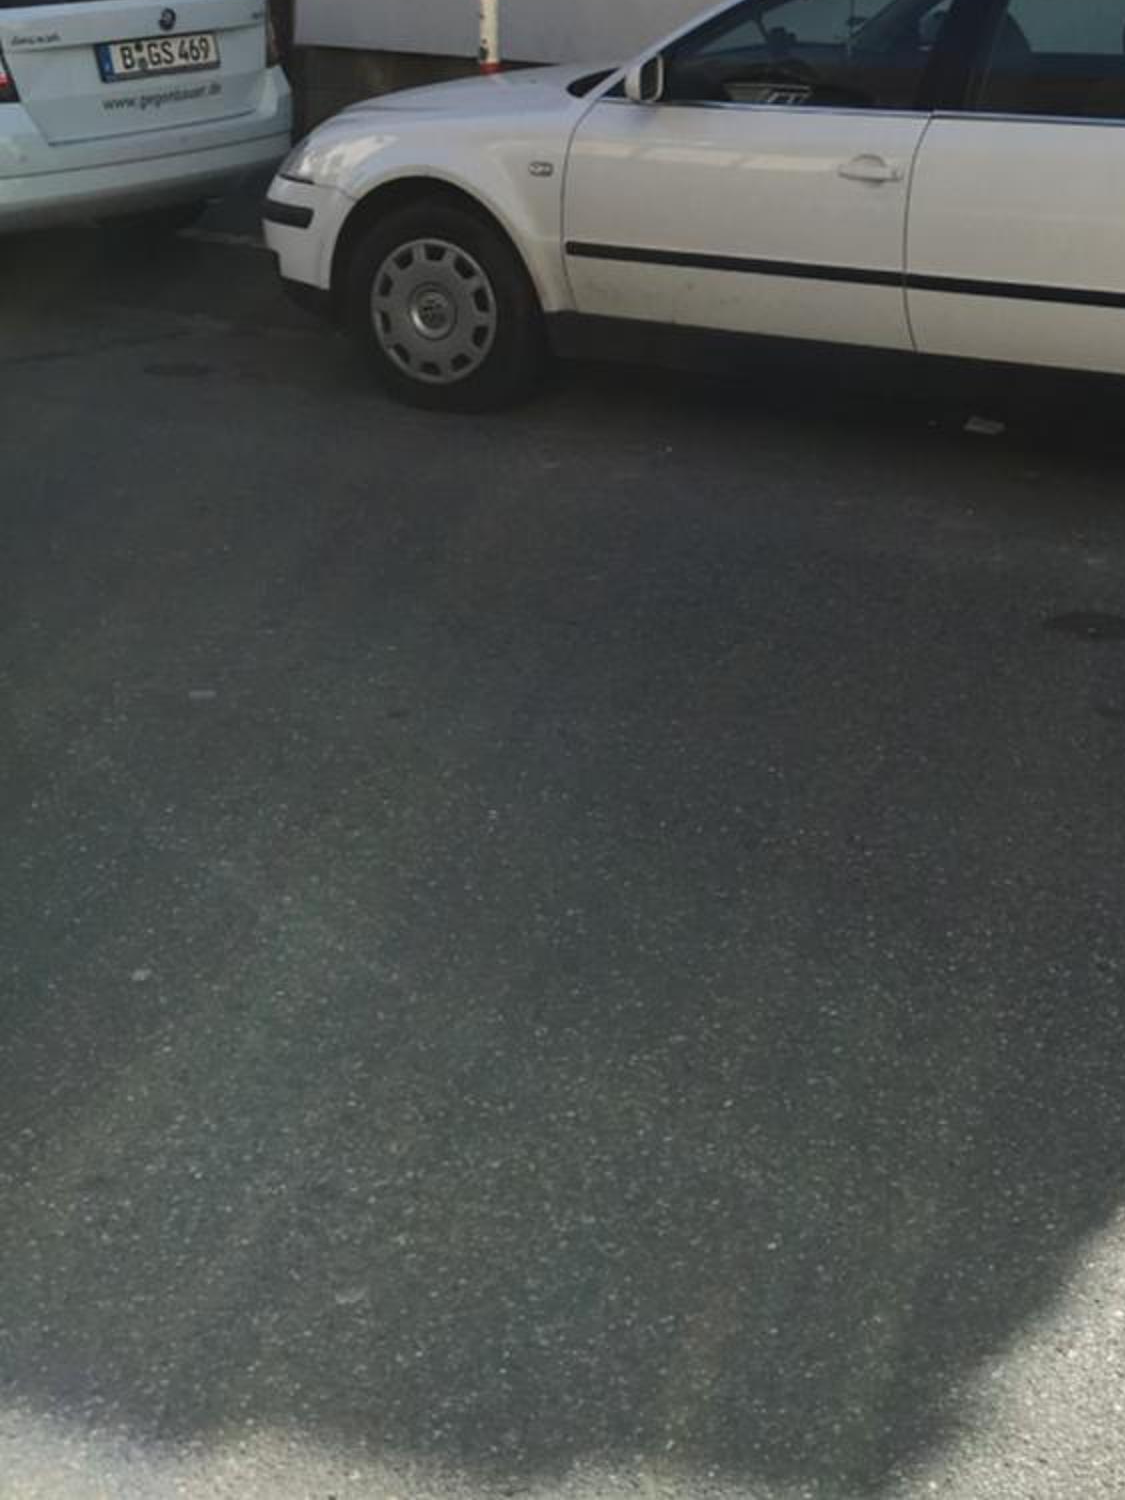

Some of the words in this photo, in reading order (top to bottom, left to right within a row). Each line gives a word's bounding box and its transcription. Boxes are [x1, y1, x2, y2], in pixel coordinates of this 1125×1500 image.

[120, 46, 135, 70] B
[147, 40, 175, 66] GS
[178, 37, 210, 61] 469
